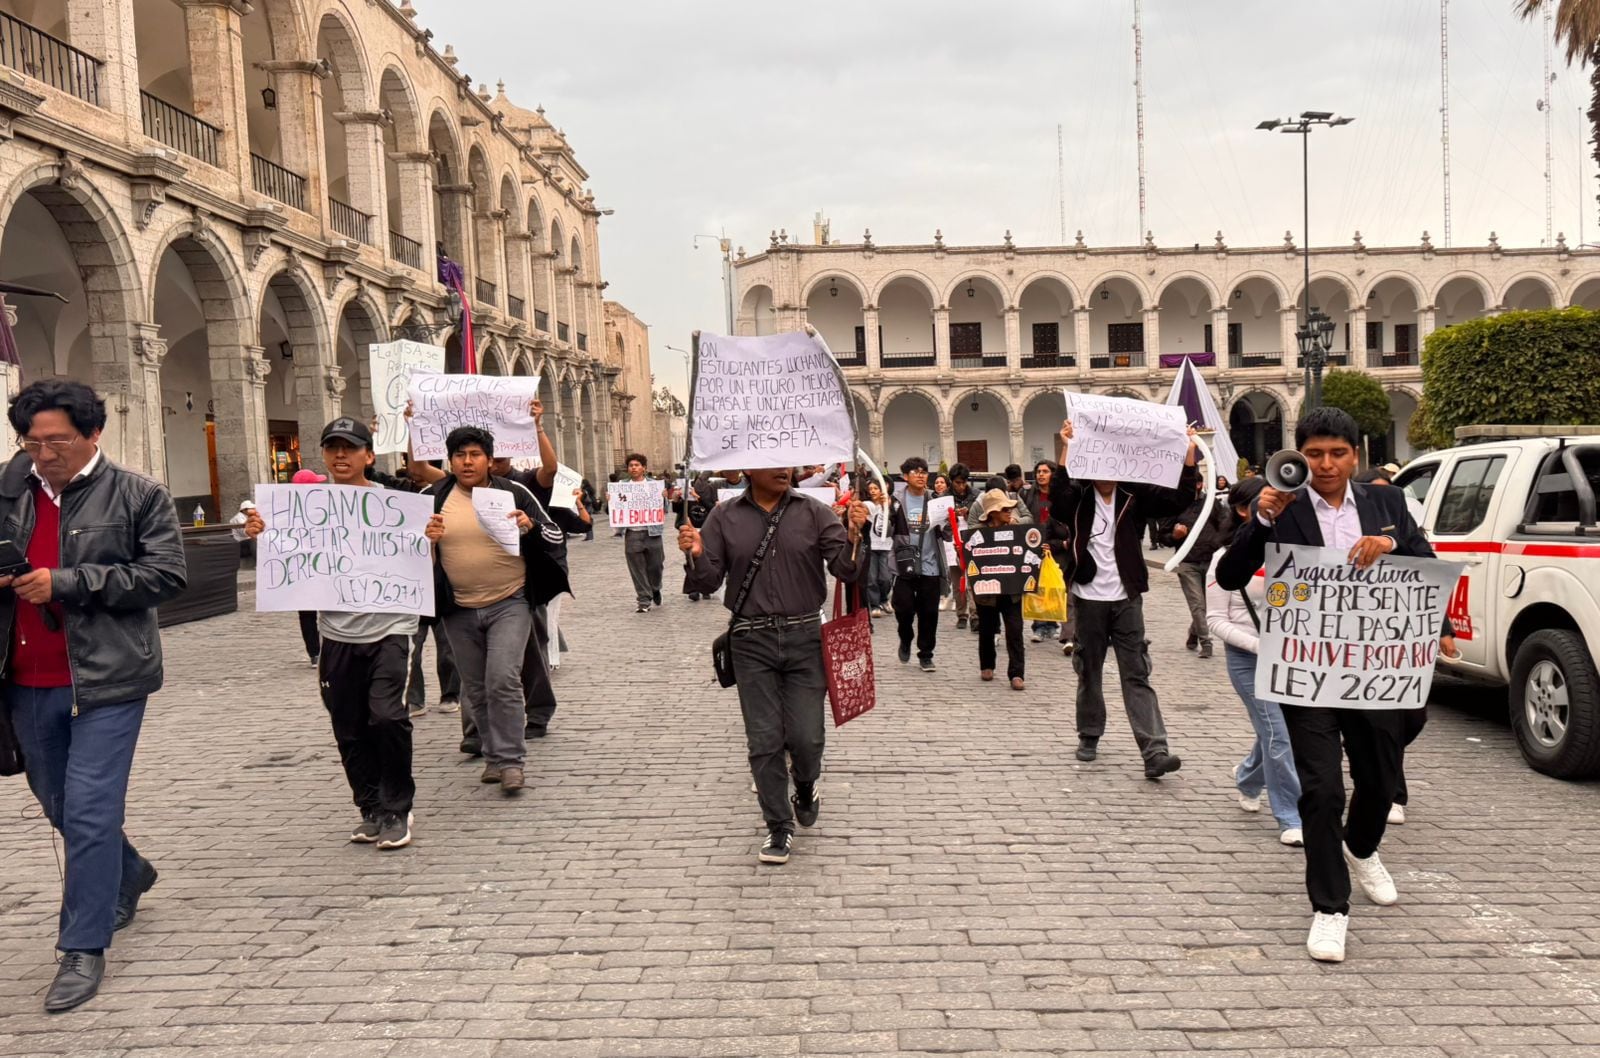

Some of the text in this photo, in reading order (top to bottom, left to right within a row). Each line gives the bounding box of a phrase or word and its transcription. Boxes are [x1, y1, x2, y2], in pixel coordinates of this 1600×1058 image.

[700, 359, 783, 377] ESTUDIANTES
[418, 376, 512, 393] CUMPLIR
[699, 372, 837, 396] POR UN FUTURO MEJOR
[423, 394, 438, 411] LA
[446, 393, 469, 411] LEY
[695, 395, 708, 412] EL
[711, 395, 752, 412] PASAJE
[412, 407, 507, 427] ES RESPETAR AL
[699, 415, 719, 432] NO
[723, 415, 739, 431] SE
[1111, 418, 1159, 440] 26271
[721, 434, 738, 450] SE
[1085, 439, 1109, 454] LEY
[1105, 456, 1164, 480] 30220
[271, 489, 405, 529] HAGAMOS
[612, 509, 624, 524] LA
[263, 526, 430, 558] RESPETAR NUESTRO
[263, 552, 354, 590] DERECHO
[1273, 550, 1424, 593] Arquitectura
[338, 578, 417, 605] LEY 26271
[1318, 584, 1440, 613] PRESENTE
[1264, 606, 1440, 641] POR EL PASAJE
[1281, 637, 1439, 671] UNIVERSITARIO
[1270, 663, 1423, 703] LEY 26271
